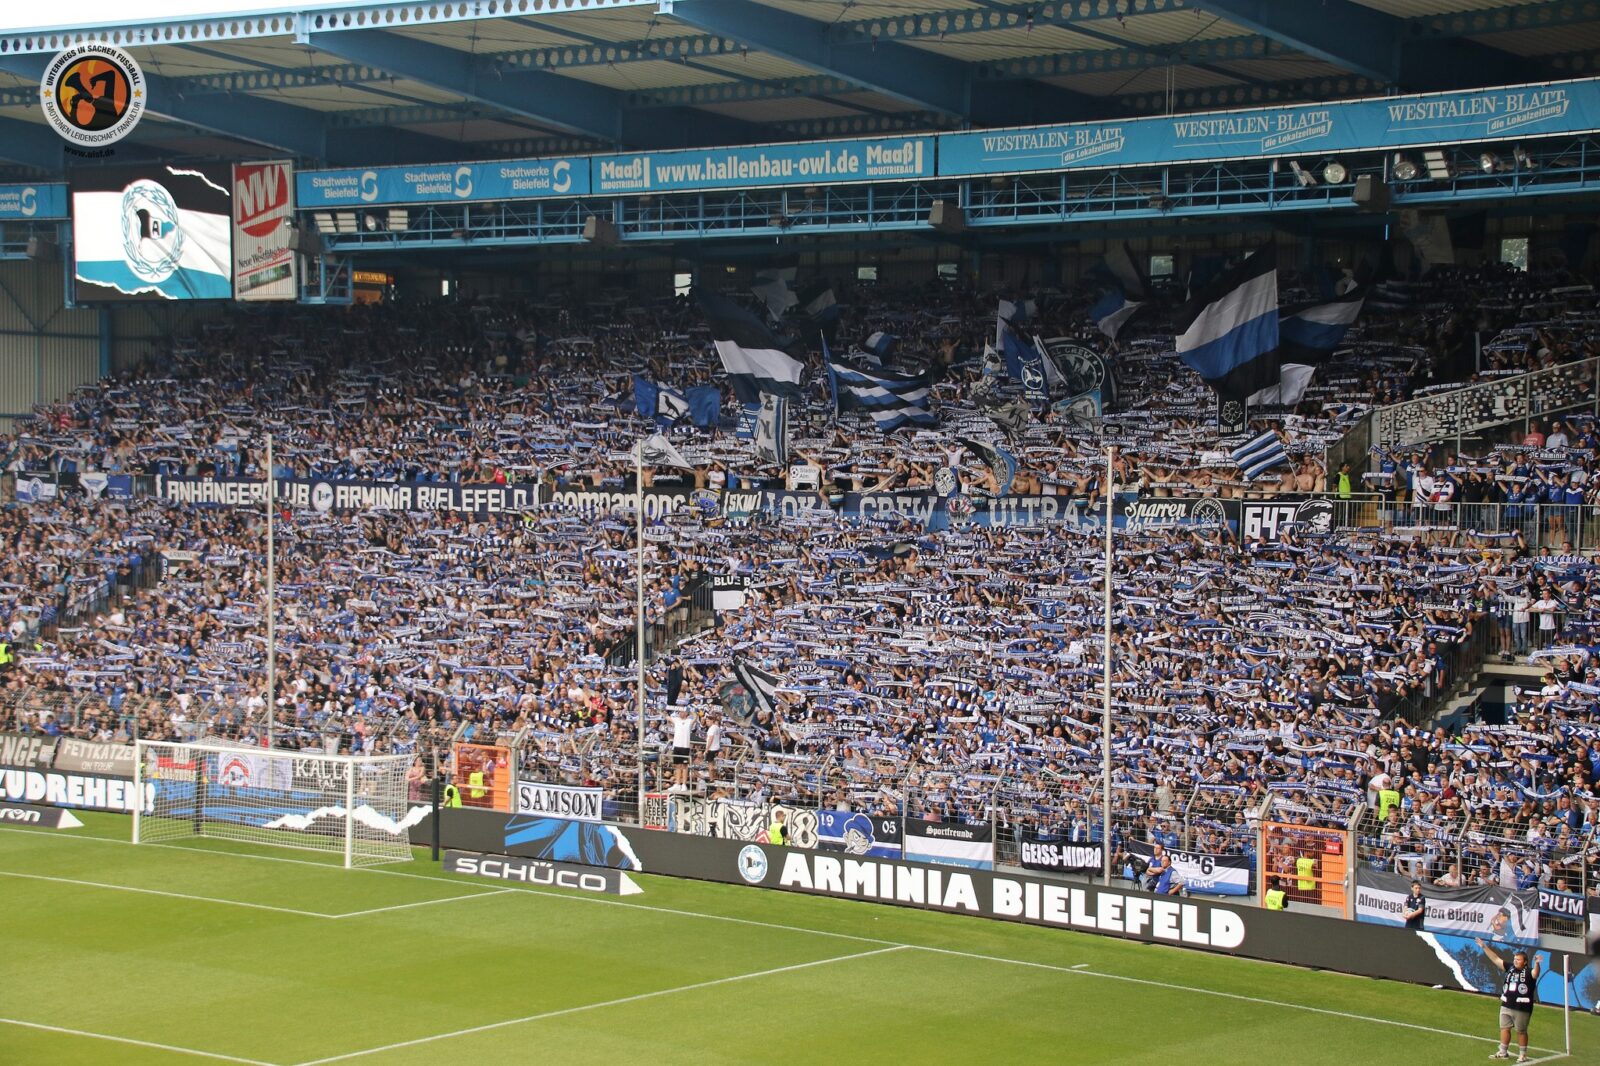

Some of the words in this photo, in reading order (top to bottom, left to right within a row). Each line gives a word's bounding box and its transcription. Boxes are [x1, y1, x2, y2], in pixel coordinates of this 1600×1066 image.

[1388, 90, 1566, 122] WESTFALEN-BLATT
[1491, 120, 1504, 131] die
[1506, 104, 1561, 128] Lokalzeitung
[1173, 110, 1330, 139] WESTFALEN-BLATT
[1264, 137, 1277, 148] die
[1278, 124, 1326, 145] Lokalzeitung
[982, 127, 1122, 153] WESTFALEN-BLATT
[1064, 151, 1076, 162] die
[1076, 140, 1119, 159] Lokalzeitung
[866, 141, 914, 165] Maaß
[404, 171, 452, 184] Stadtwerke
[500, 166, 549, 179] Stadtwerke
[600, 158, 642, 180] Maaß
[656, 149, 859, 183] www.hallenbau-owl.de
[866, 163, 915, 176] INDUSTRIEBAU
[236, 165, 281, 223] NW
[312, 176, 358, 188] Stadtwerke
[324, 187, 359, 199] Bielefeld
[416, 182, 452, 195] Bielefeld
[512, 177, 550, 190] Bielefeld
[601, 178, 643, 190] INDUSTRIEBAU
[335, 485, 412, 509] ARMINIA
[417, 486, 528, 513] BIELEFELD
[988, 496, 1102, 530] ULTRAS
[1245, 506, 1297, 540] 647
[0, 735, 42, 769] NGE
[520, 786, 599, 817] SAMSON
[820, 813, 835, 828] 19
[882, 820, 897, 834] 05
[926, 825, 974, 839] Sportfreunde
[1021, 841, 1101, 869] GEISS-NIDDA
[1200, 856, 1214, 875] 6
[455, 857, 607, 892] SCHÜCO
[779, 852, 980, 912] ARMINIA
[992, 877, 1246, 949] BIELEFELD
[1448, 907, 1484, 924] Bünde
